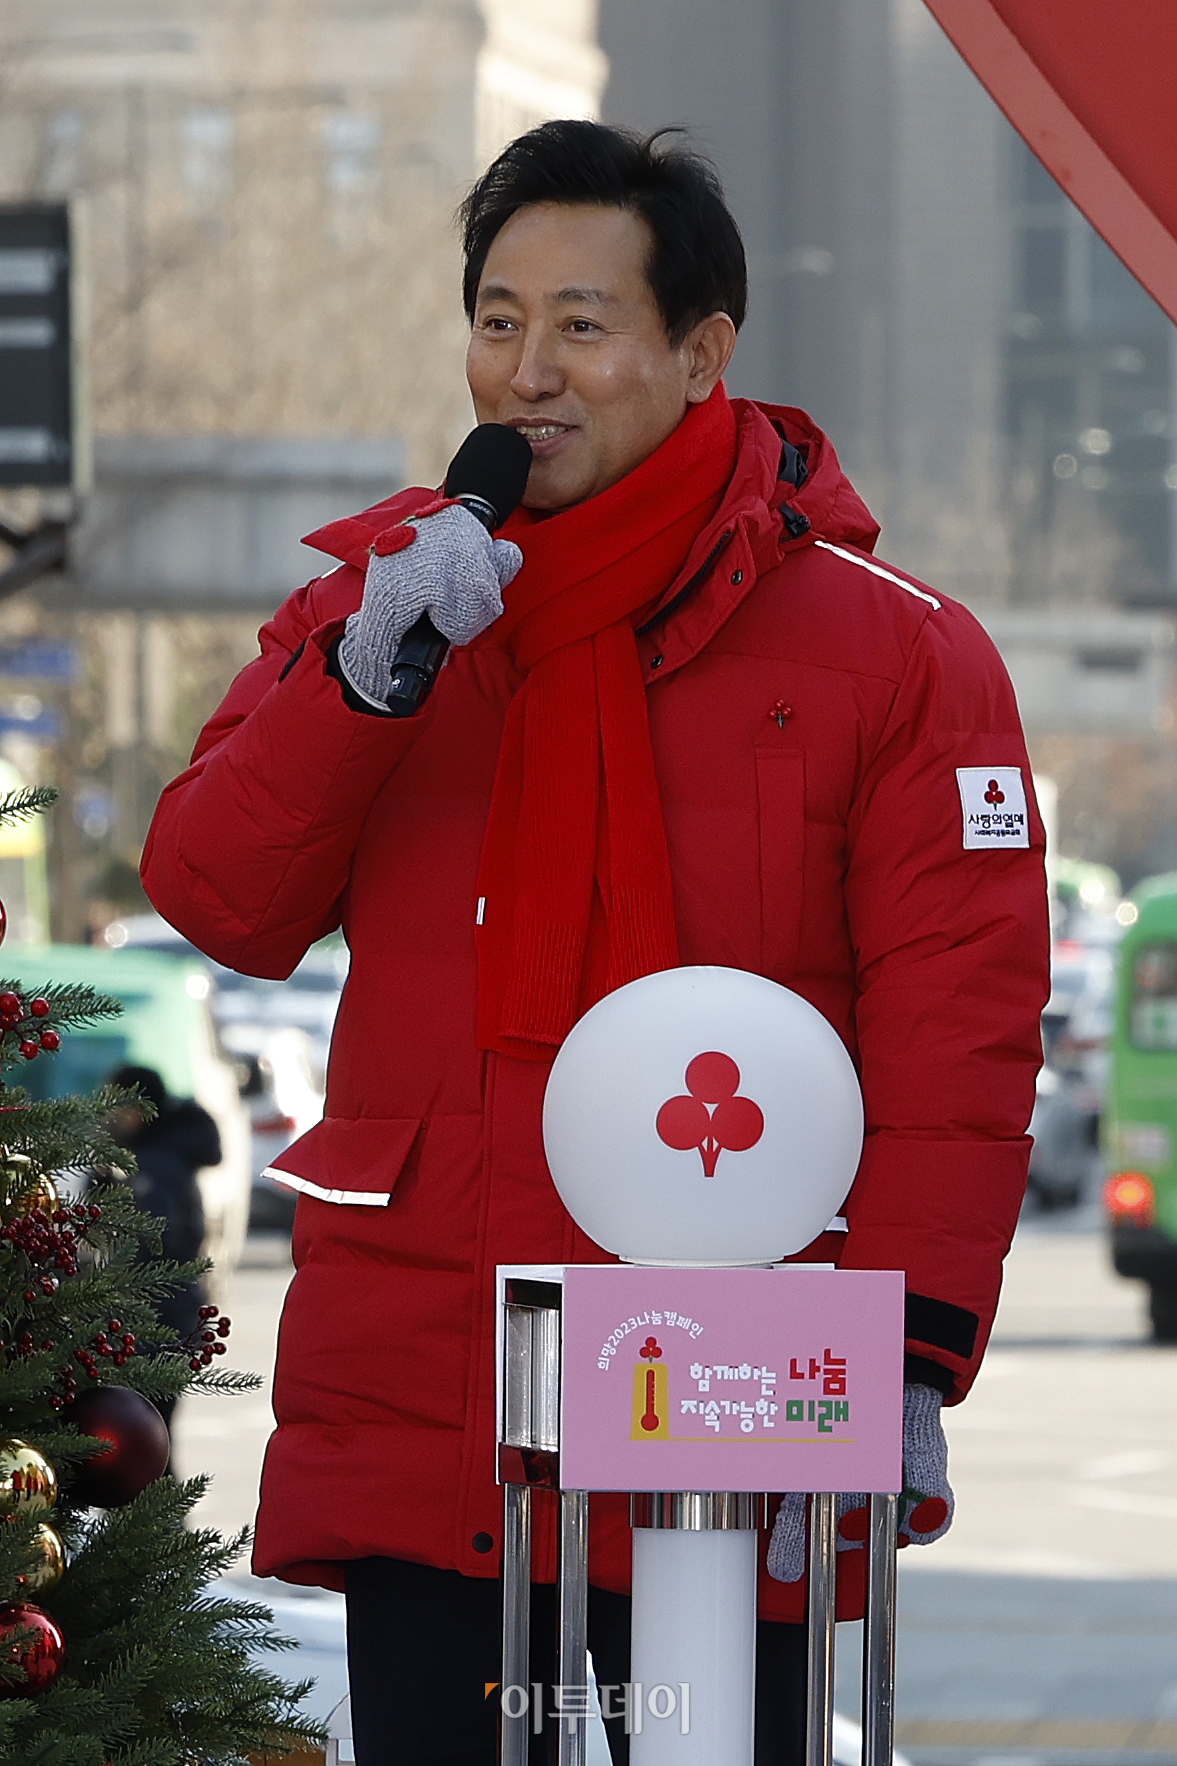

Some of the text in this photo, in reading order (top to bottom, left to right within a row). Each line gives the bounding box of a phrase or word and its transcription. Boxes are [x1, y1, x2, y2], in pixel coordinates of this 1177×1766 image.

[968, 813, 1024, 829] 사랑의열매
[690, 1348, 847, 1396] 함께하는 나눔
[680, 1398, 849, 1433] 지속가능한 미래
